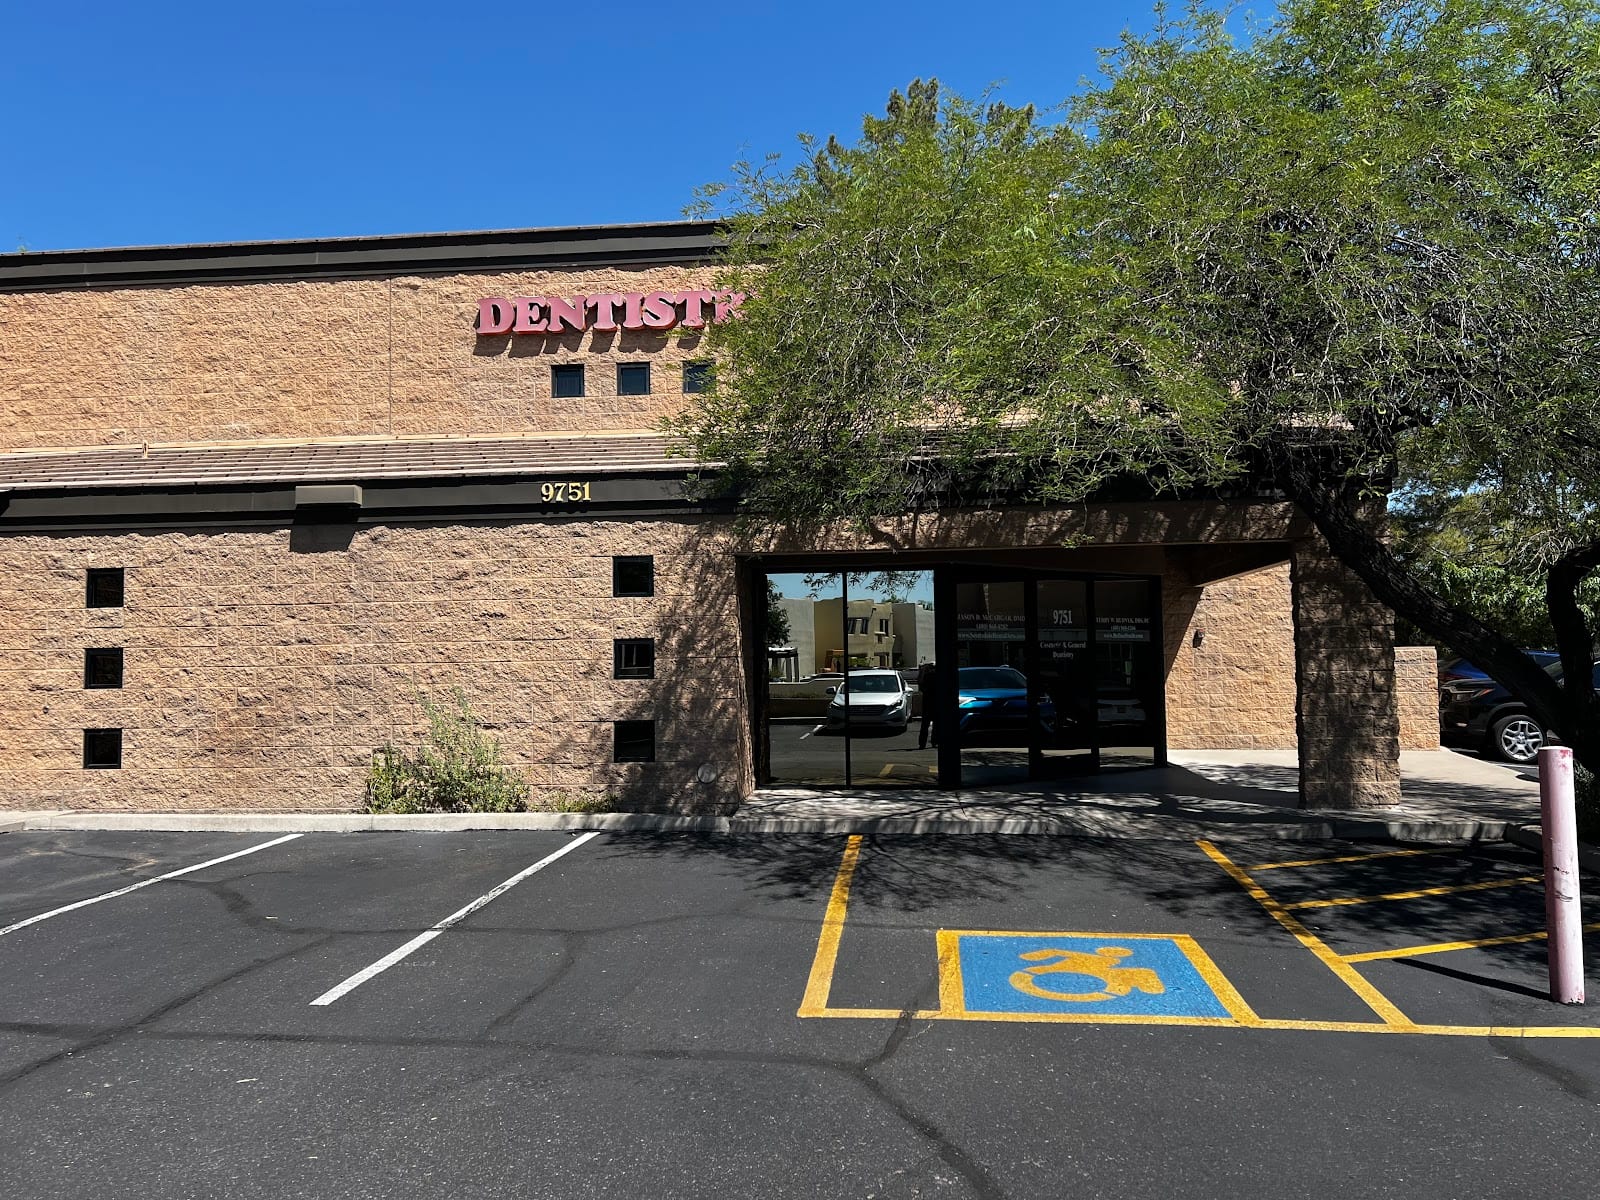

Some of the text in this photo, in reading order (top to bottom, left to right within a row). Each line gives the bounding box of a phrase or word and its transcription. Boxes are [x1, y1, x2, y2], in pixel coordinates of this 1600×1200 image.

[475, 288, 761, 335] DENTISTR
[541, 482, 591, 502] 9751
[1053, 609, 1073, 625] 9751
[1067, 641, 1086, 649] General
[1052, 651, 1074, 660] Dentistry
